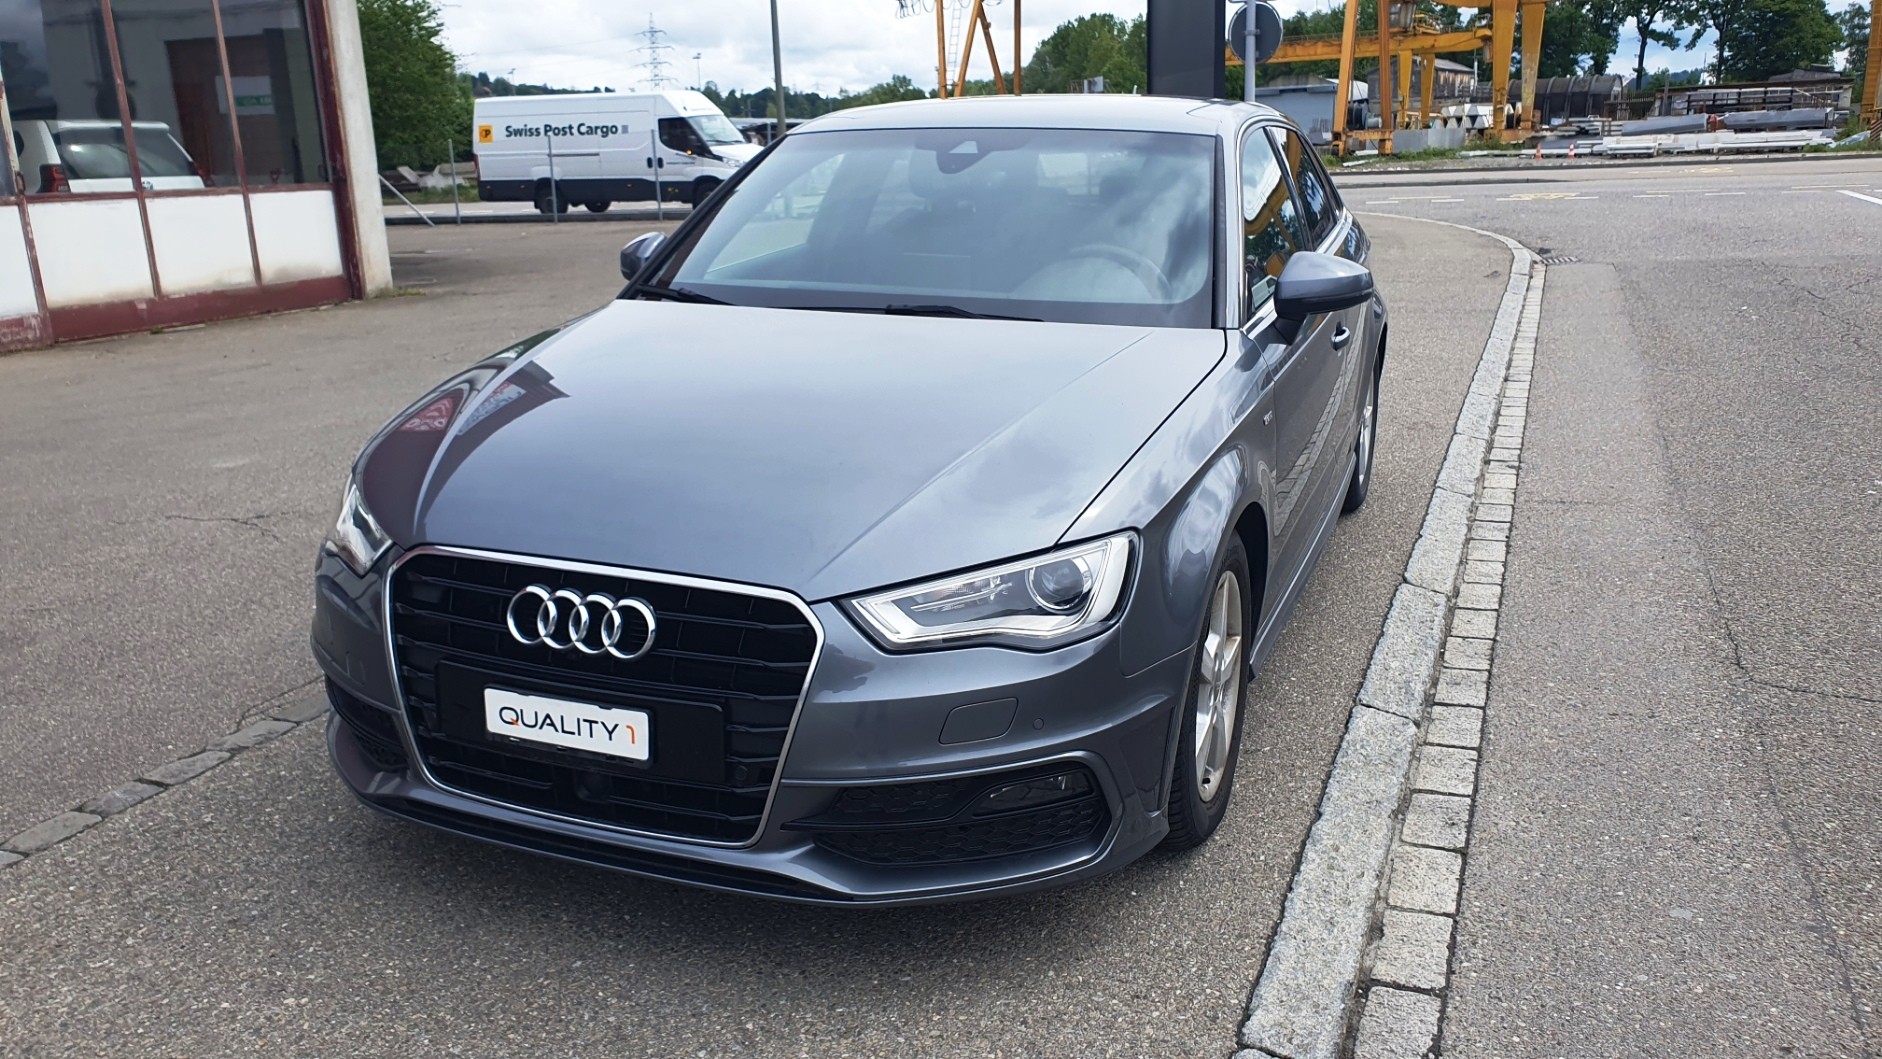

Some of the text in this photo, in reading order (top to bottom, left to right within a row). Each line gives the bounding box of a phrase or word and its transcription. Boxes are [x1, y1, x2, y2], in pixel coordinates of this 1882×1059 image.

[505, 122, 618, 138] Swiss Post Cargo
[499, 706, 635, 744] QUALITY 1
